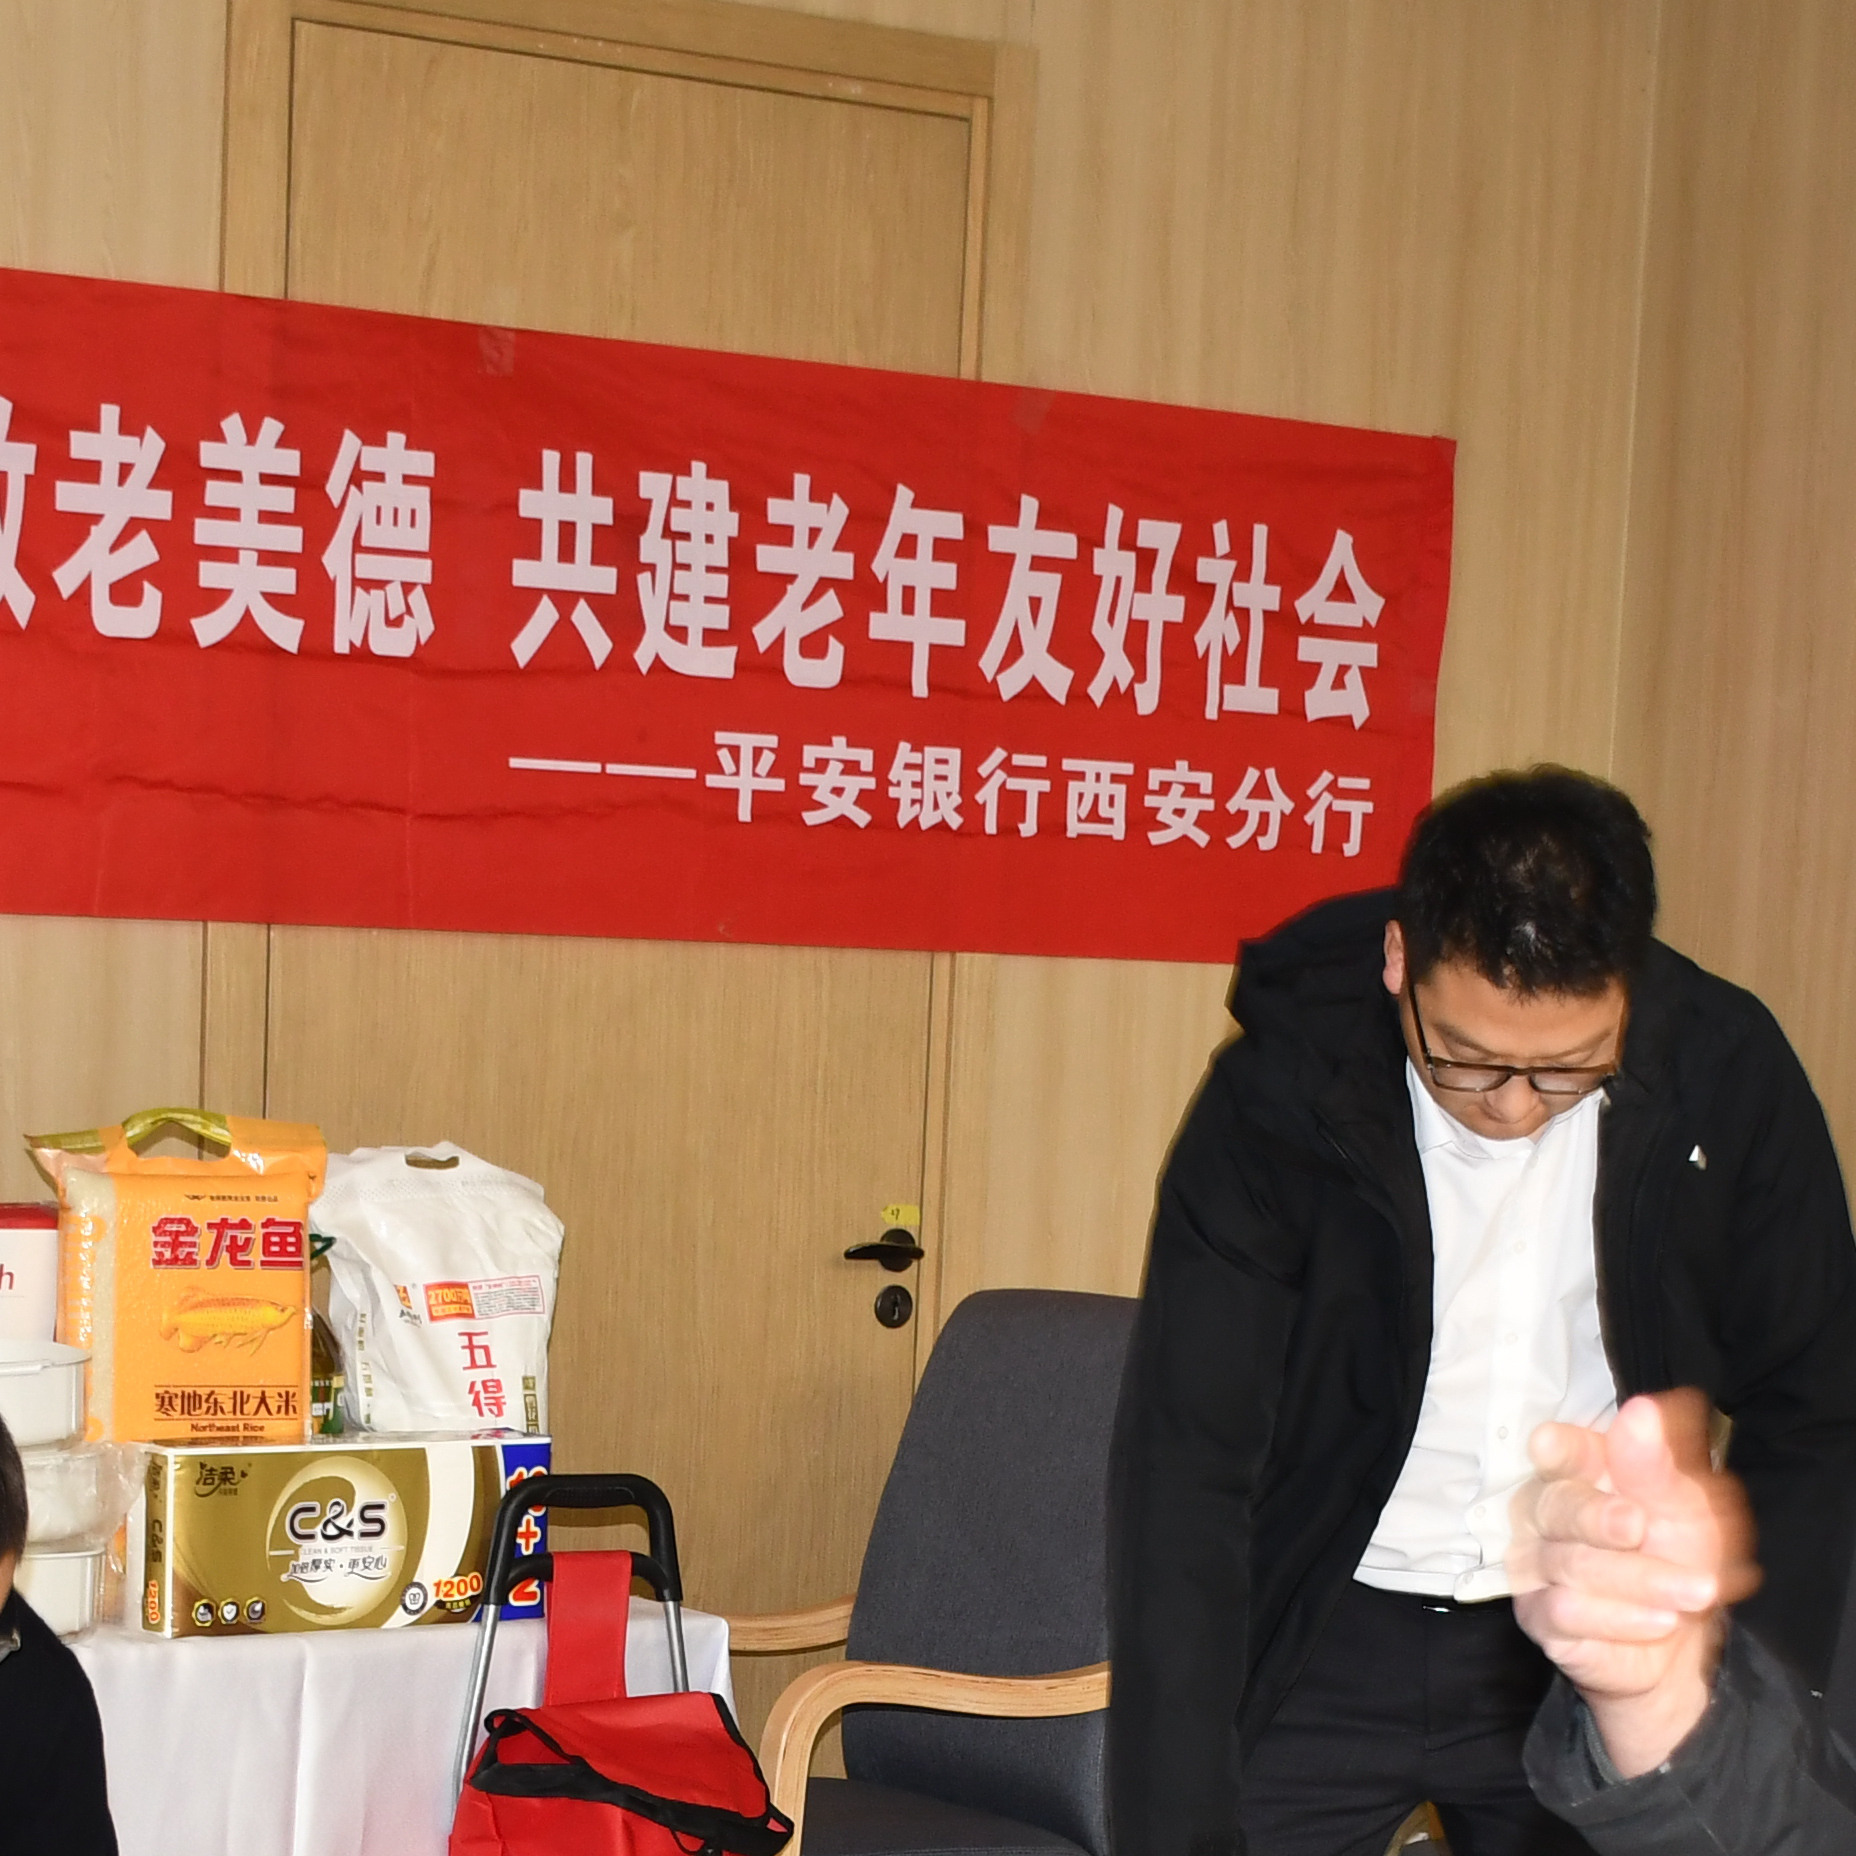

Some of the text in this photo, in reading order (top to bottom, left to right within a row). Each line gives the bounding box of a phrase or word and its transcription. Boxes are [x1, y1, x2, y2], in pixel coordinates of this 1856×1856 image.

[509, 448, 1386, 731] 共建老年友好社会
[151, 1217, 305, 1270] 金龙鱼
[154, 1389, 298, 1417] 寒地东北大米
[191, 1422, 265, 1433] Northeast Rice
[287, 1499, 388, 1542] C&S
[432, 1574, 482, 1598] 1200
